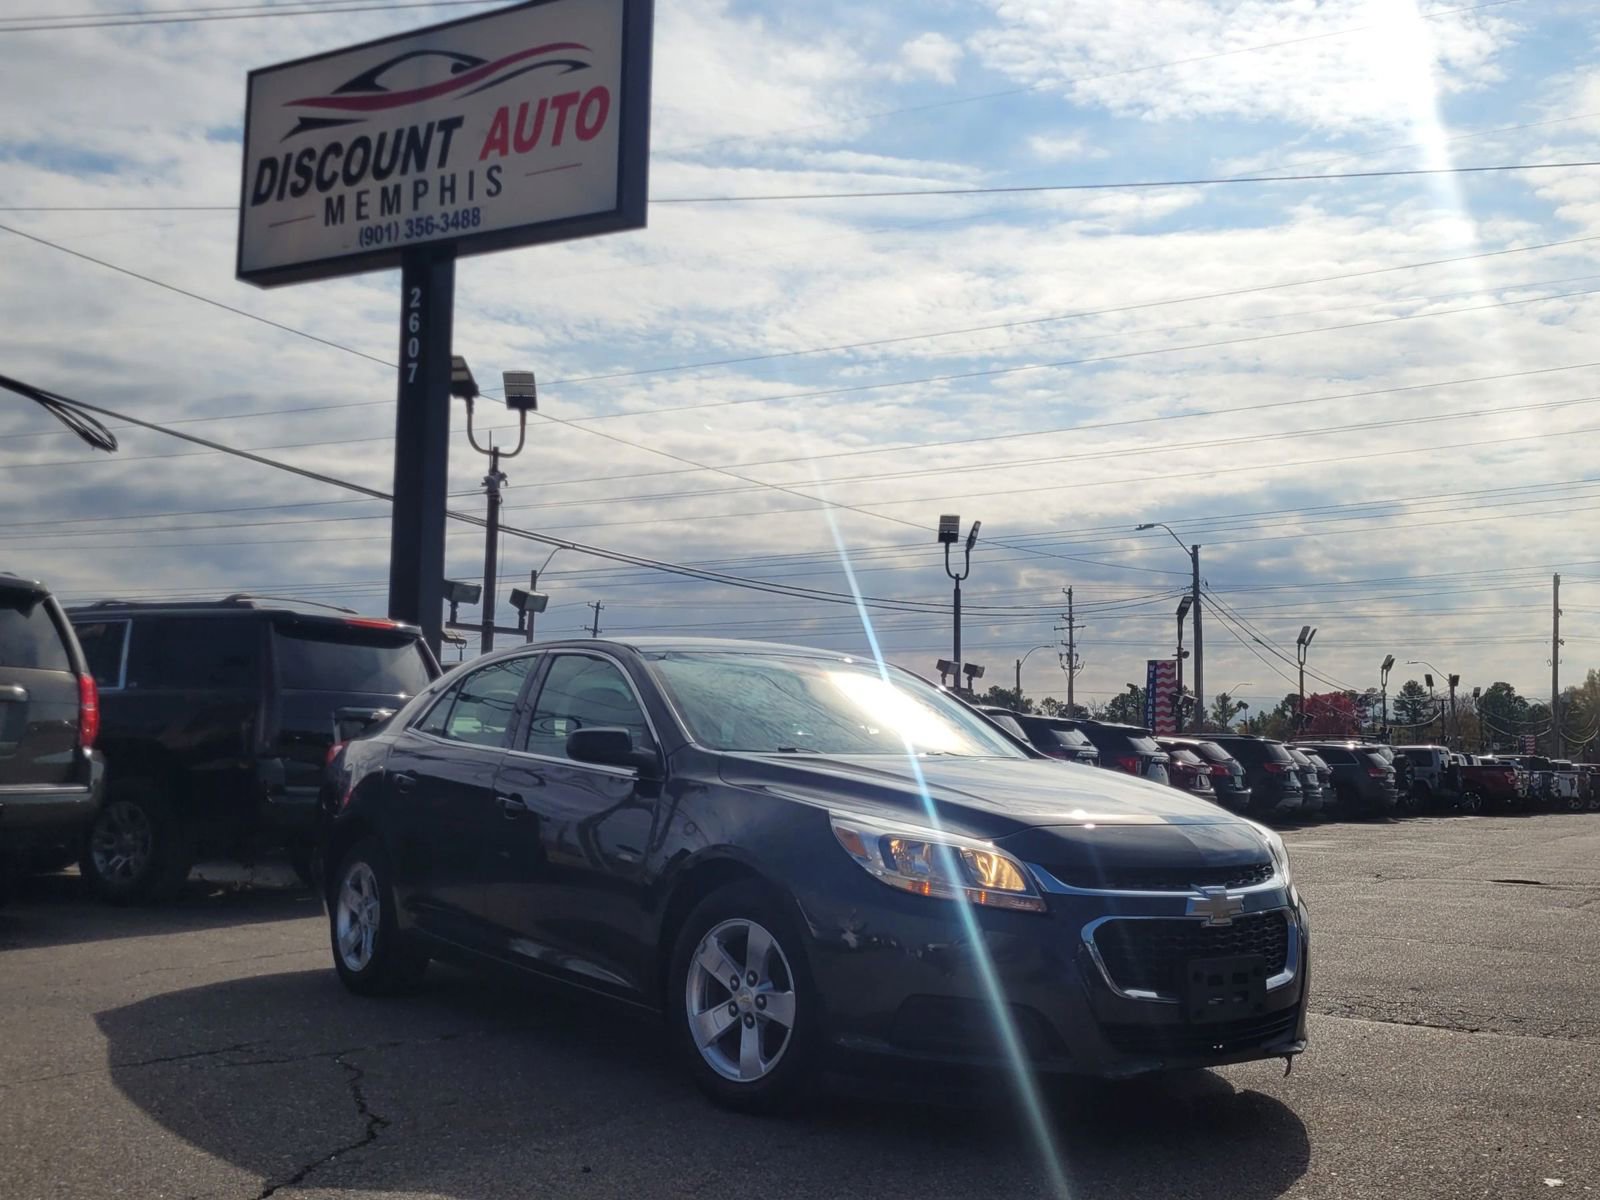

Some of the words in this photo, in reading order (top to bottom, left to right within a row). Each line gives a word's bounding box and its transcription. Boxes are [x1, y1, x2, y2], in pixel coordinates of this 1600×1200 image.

[251, 115, 464, 206] DISCOUNT
[479, 85, 611, 161] AUTO
[324, 164, 503, 227] MEMPHIS
[358, 221, 400, 248] (901)
[404, 206, 482, 239] 356-3488
[407, 287, 422, 384] 2607
